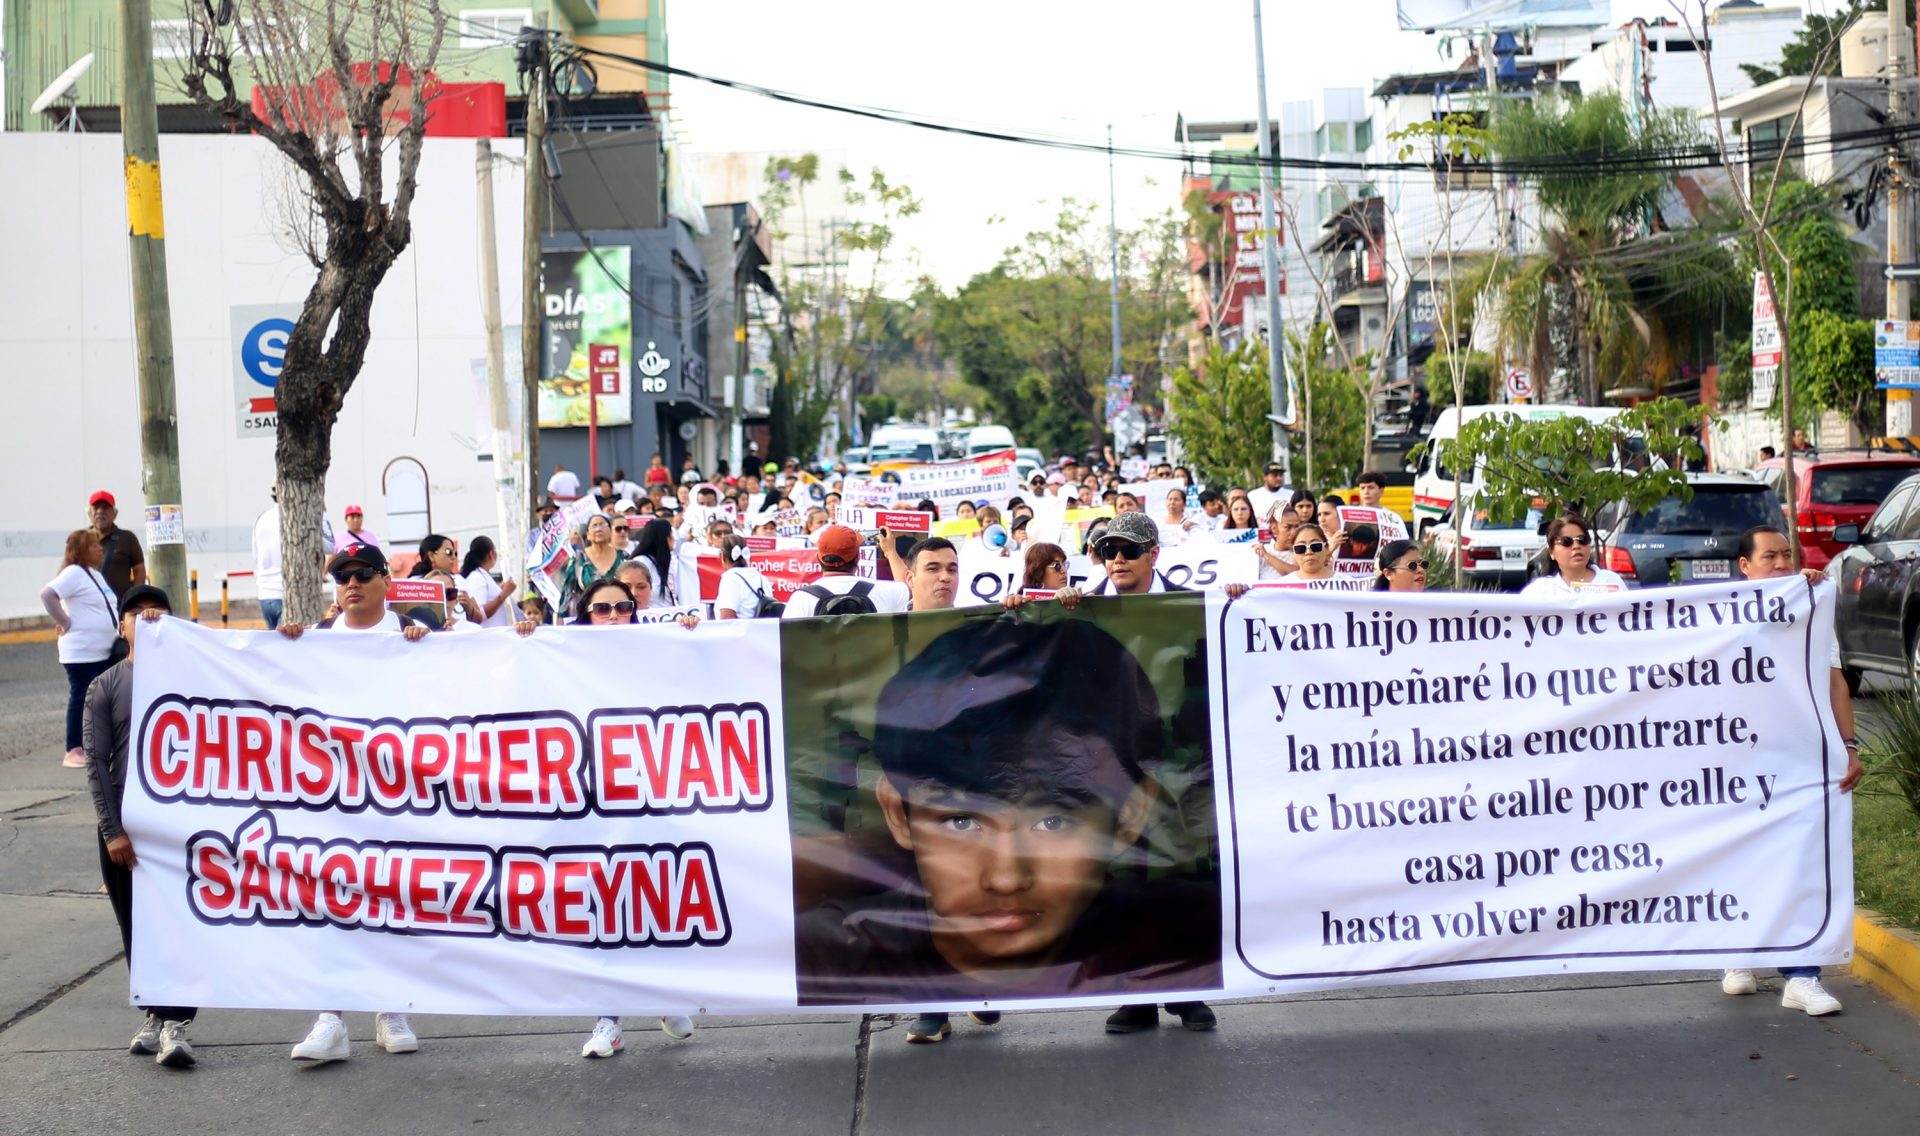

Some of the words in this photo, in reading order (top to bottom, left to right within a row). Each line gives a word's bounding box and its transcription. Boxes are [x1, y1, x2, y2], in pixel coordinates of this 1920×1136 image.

[545, 288, 605, 316] DÍAS
[602, 374, 615, 392] E
[641, 377, 668, 393] RD
[788, 559, 824, 573] Evan
[1244, 618, 1335, 653] Evan
[1345, 611, 1418, 655] hijo
[1429, 609, 1513, 644] mío:
[1522, 613, 1564, 647] yo
[1575, 609, 1608, 635] te
[1618, 600, 1654, 632] di
[1665, 598, 1697, 628] la
[1708, 589, 1797, 627] vida,
[1273, 685, 1292, 722] y
[1303, 662, 1491, 717] empeñaré
[1502, 663, 1537, 698] lo
[1547, 667, 1616, 705] que
[1628, 656, 1722, 692] resta
[1731, 646, 1776, 684] de
[145, 705, 582, 809] CHRISTOPHER
[597, 714, 765, 806] EVAN
[1286, 734, 1320, 772] la
[1331, 729, 1402, 768] mía
[1412, 727, 1513, 765] hasta
[1524, 712, 1759, 756] encontrarte,
[1285, 800, 1320, 832] te
[1328, 783, 1477, 830] buscaré
[1488, 778, 1573, 819] calle
[1583, 781, 1649, 822] por
[1660, 766, 1747, 807] calle
[1756, 774, 1777, 810] y
[194, 826, 492, 928] SÁNCHEZ
[502, 853, 722, 940] REYNA
[1404, 852, 1485, 885] casa
[1495, 847, 1561, 887] por
[1570, 842, 1664, 873] casa,
[1321, 910, 1422, 946] hasta
[1431, 901, 1547, 938] volver
[1556, 887, 1750, 931] abrazarte.
